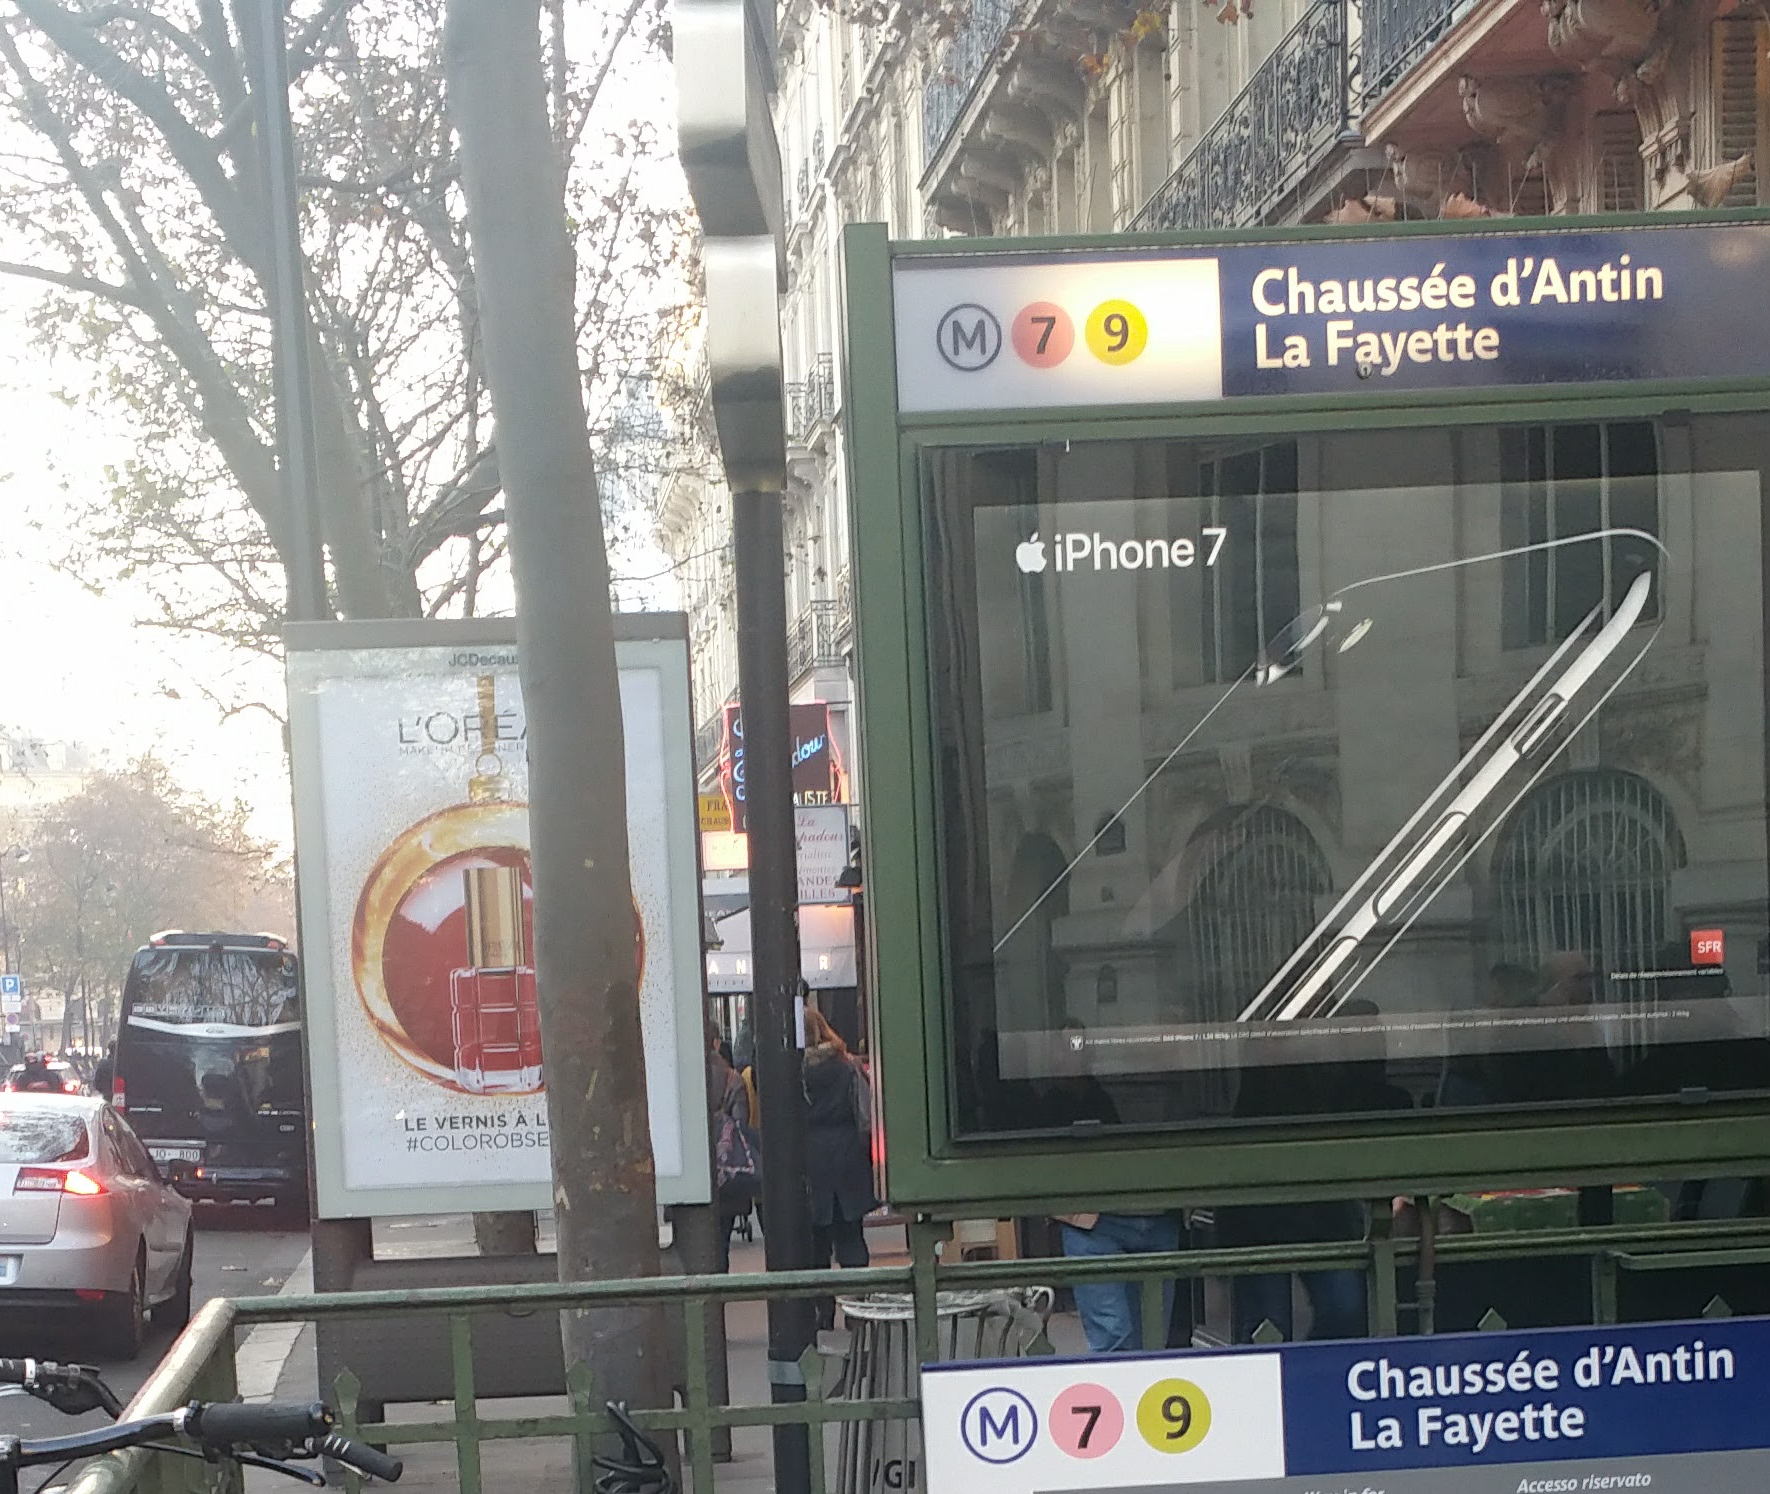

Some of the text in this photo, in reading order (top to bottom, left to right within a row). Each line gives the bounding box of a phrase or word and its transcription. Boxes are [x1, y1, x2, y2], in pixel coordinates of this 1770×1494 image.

[1252, 254, 1664, 316] Chaussée d’Antin
[1031, 317, 1056, 354] 7
[1104, 314, 1129, 352] 9
[1255, 319, 1500, 376] La Fayette
[1054, 528, 1227, 572] iPhone 7
[1698, 941, 1722, 954] SFR
[405, 1118, 426, 1131] LE
[435, 1114, 506, 1129] VERNIS
[516, 1110, 528, 1127] À
[407, 1131, 549, 1151] #COLOROBSE
[1347, 1340, 1734, 1401] Chaussée d’Antin
[1071, 1405, 1101, 1449] 7
[1161, 1395, 1191, 1440] 9
[1350, 1404, 1585, 1453] La Fayette
[1517, 1472, 1651, 1493] Accesso riservato
